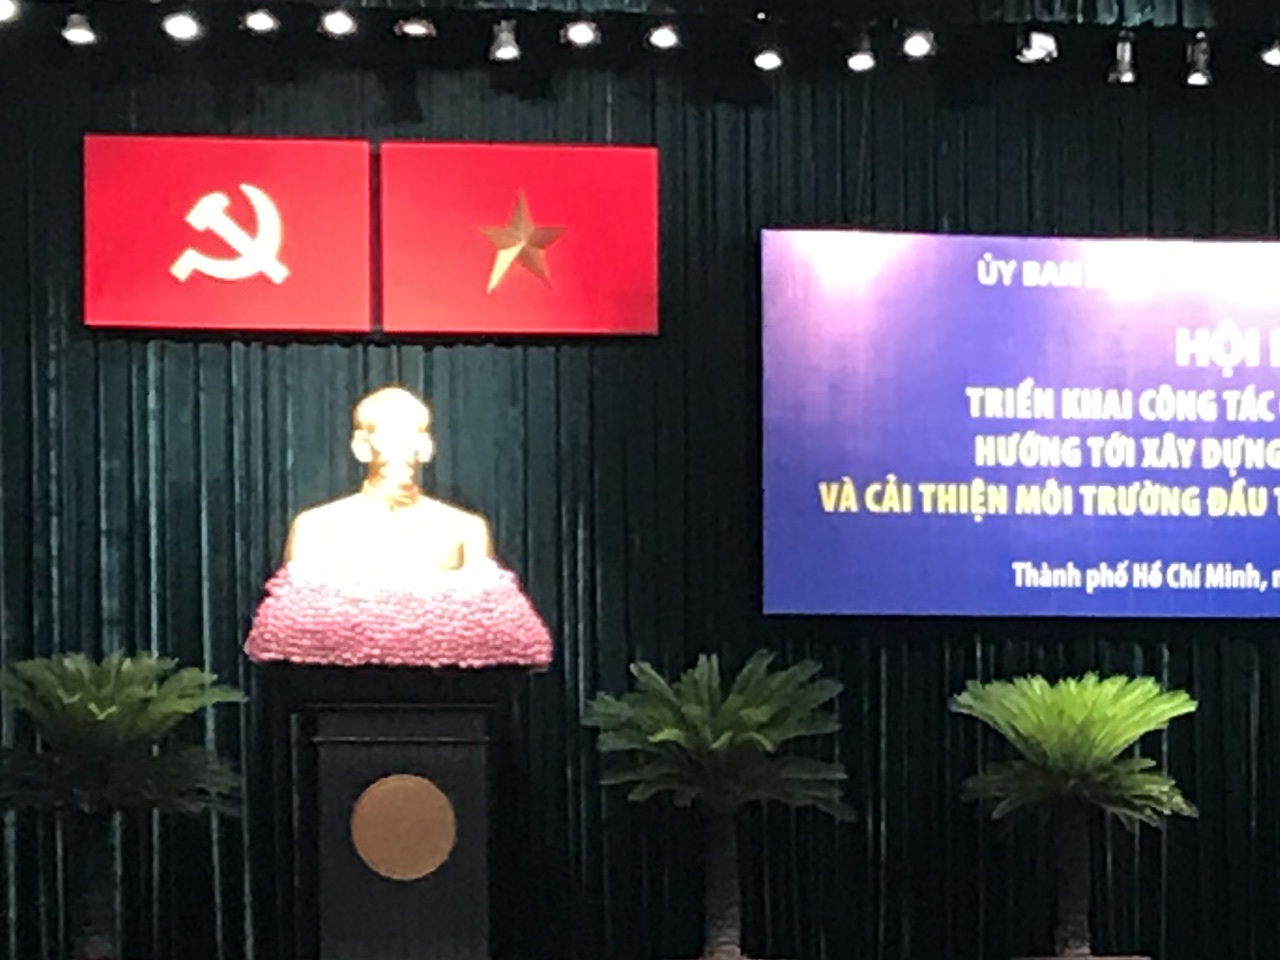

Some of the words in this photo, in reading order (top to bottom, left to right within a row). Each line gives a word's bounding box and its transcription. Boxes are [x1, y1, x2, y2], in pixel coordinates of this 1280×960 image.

[977, 252, 1016, 286] ỦY
[1022, 259, 1083, 287] BAN
[1175, 317, 1260, 378] HỘI
[1061, 387, 1133, 420] KHAI
[1138, 384, 1218, 422] CÔNG
[1222, 384, 1275, 422] TÁC
[974, 430, 1082, 468] HƯỚNG
[1086, 431, 1136, 468] TỚI
[1140, 432, 1196, 469] XÂY
[818, 476, 858, 513] VÀ
[865, 473, 912, 513] CẢI
[918, 477, 1008, 522] THIỆN
[1015, 478, 1073, 516] MÔI
[1079, 480, 1201, 517] TRƯỜNG
[1011, 561, 1082, 588] Thành
[1086, 560, 1130, 594] phố
[1166, 562, 1202, 589] Chí
[1204, 562, 1269, 593] Minh,
